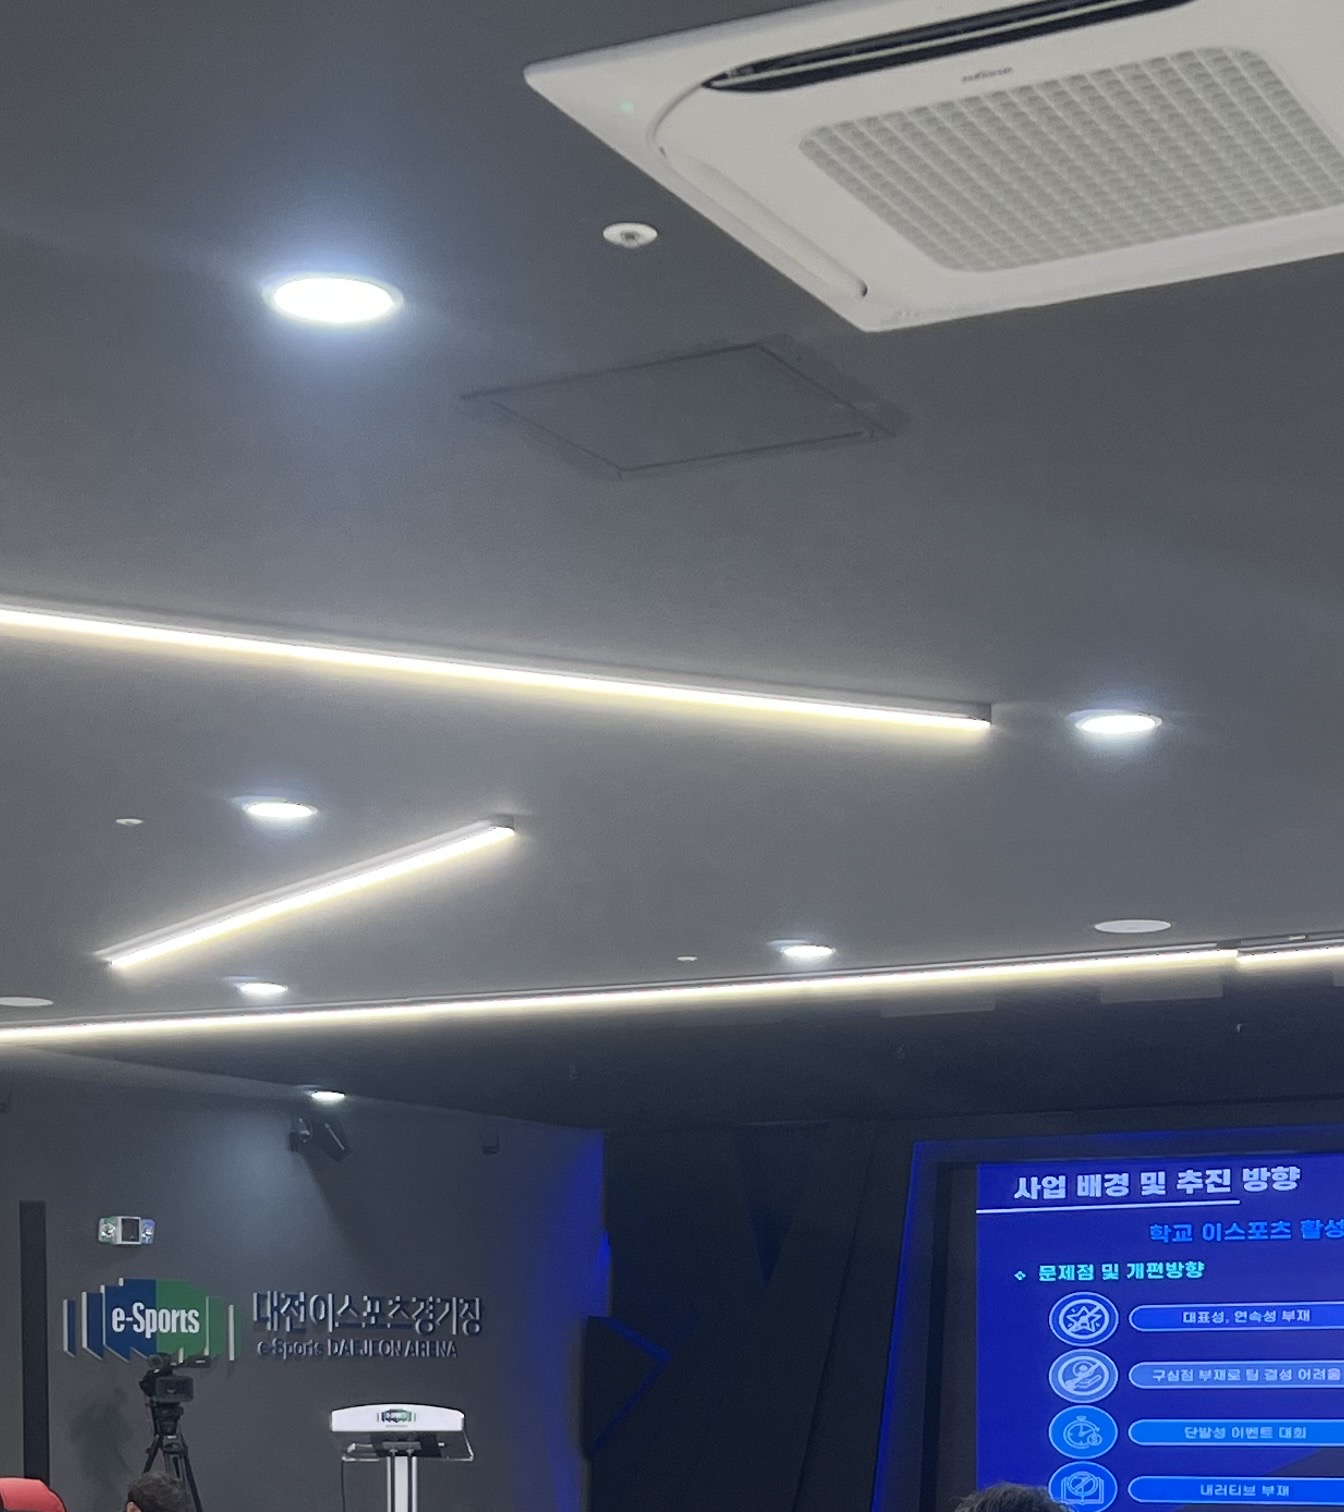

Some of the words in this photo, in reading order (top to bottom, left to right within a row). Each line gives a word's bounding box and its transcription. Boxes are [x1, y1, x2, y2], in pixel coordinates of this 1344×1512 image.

[1014, 1174, 1067, 1201] 사업
[1076, 1172, 1129, 1198] 배경
[1140, 1170, 1167, 1195] 및
[1176, 1168, 1232, 1194] 추진
[1242, 1165, 1301, 1191] 방향
[1150, 1223, 1193, 1244] 학교
[1203, 1220, 1292, 1242] 이스포츠
[1038, 1263, 1095, 1282] 문제점
[1102, 1263, 1119, 1281] 및
[1127, 1261, 1205, 1281] 개편방향
[112, 1302, 199, 1338] e-Sports
[1183, 1311, 1230, 1325] 대표성,
[1234, 1310, 1277, 1324] 연속성
[1282, 1309, 1310, 1323] 부재
[257, 1338, 324, 1360] e-Sports
[327, 1339, 401, 1357] DAEJEON
[404, 1340, 457, 1358] ARENA
[1152, 1369, 1194, 1382] 구심점
[1199, 1369, 1241, 1382] 부재로
[1184, 1426, 1226, 1440] 단발성
[1232, 1426, 1273, 1439] 이벤트
[1279, 1426, 1307, 1439] 대회
[1200, 1484, 1256, 1497] 내러티브
[1262, 1484, 1290, 1497] 부재
